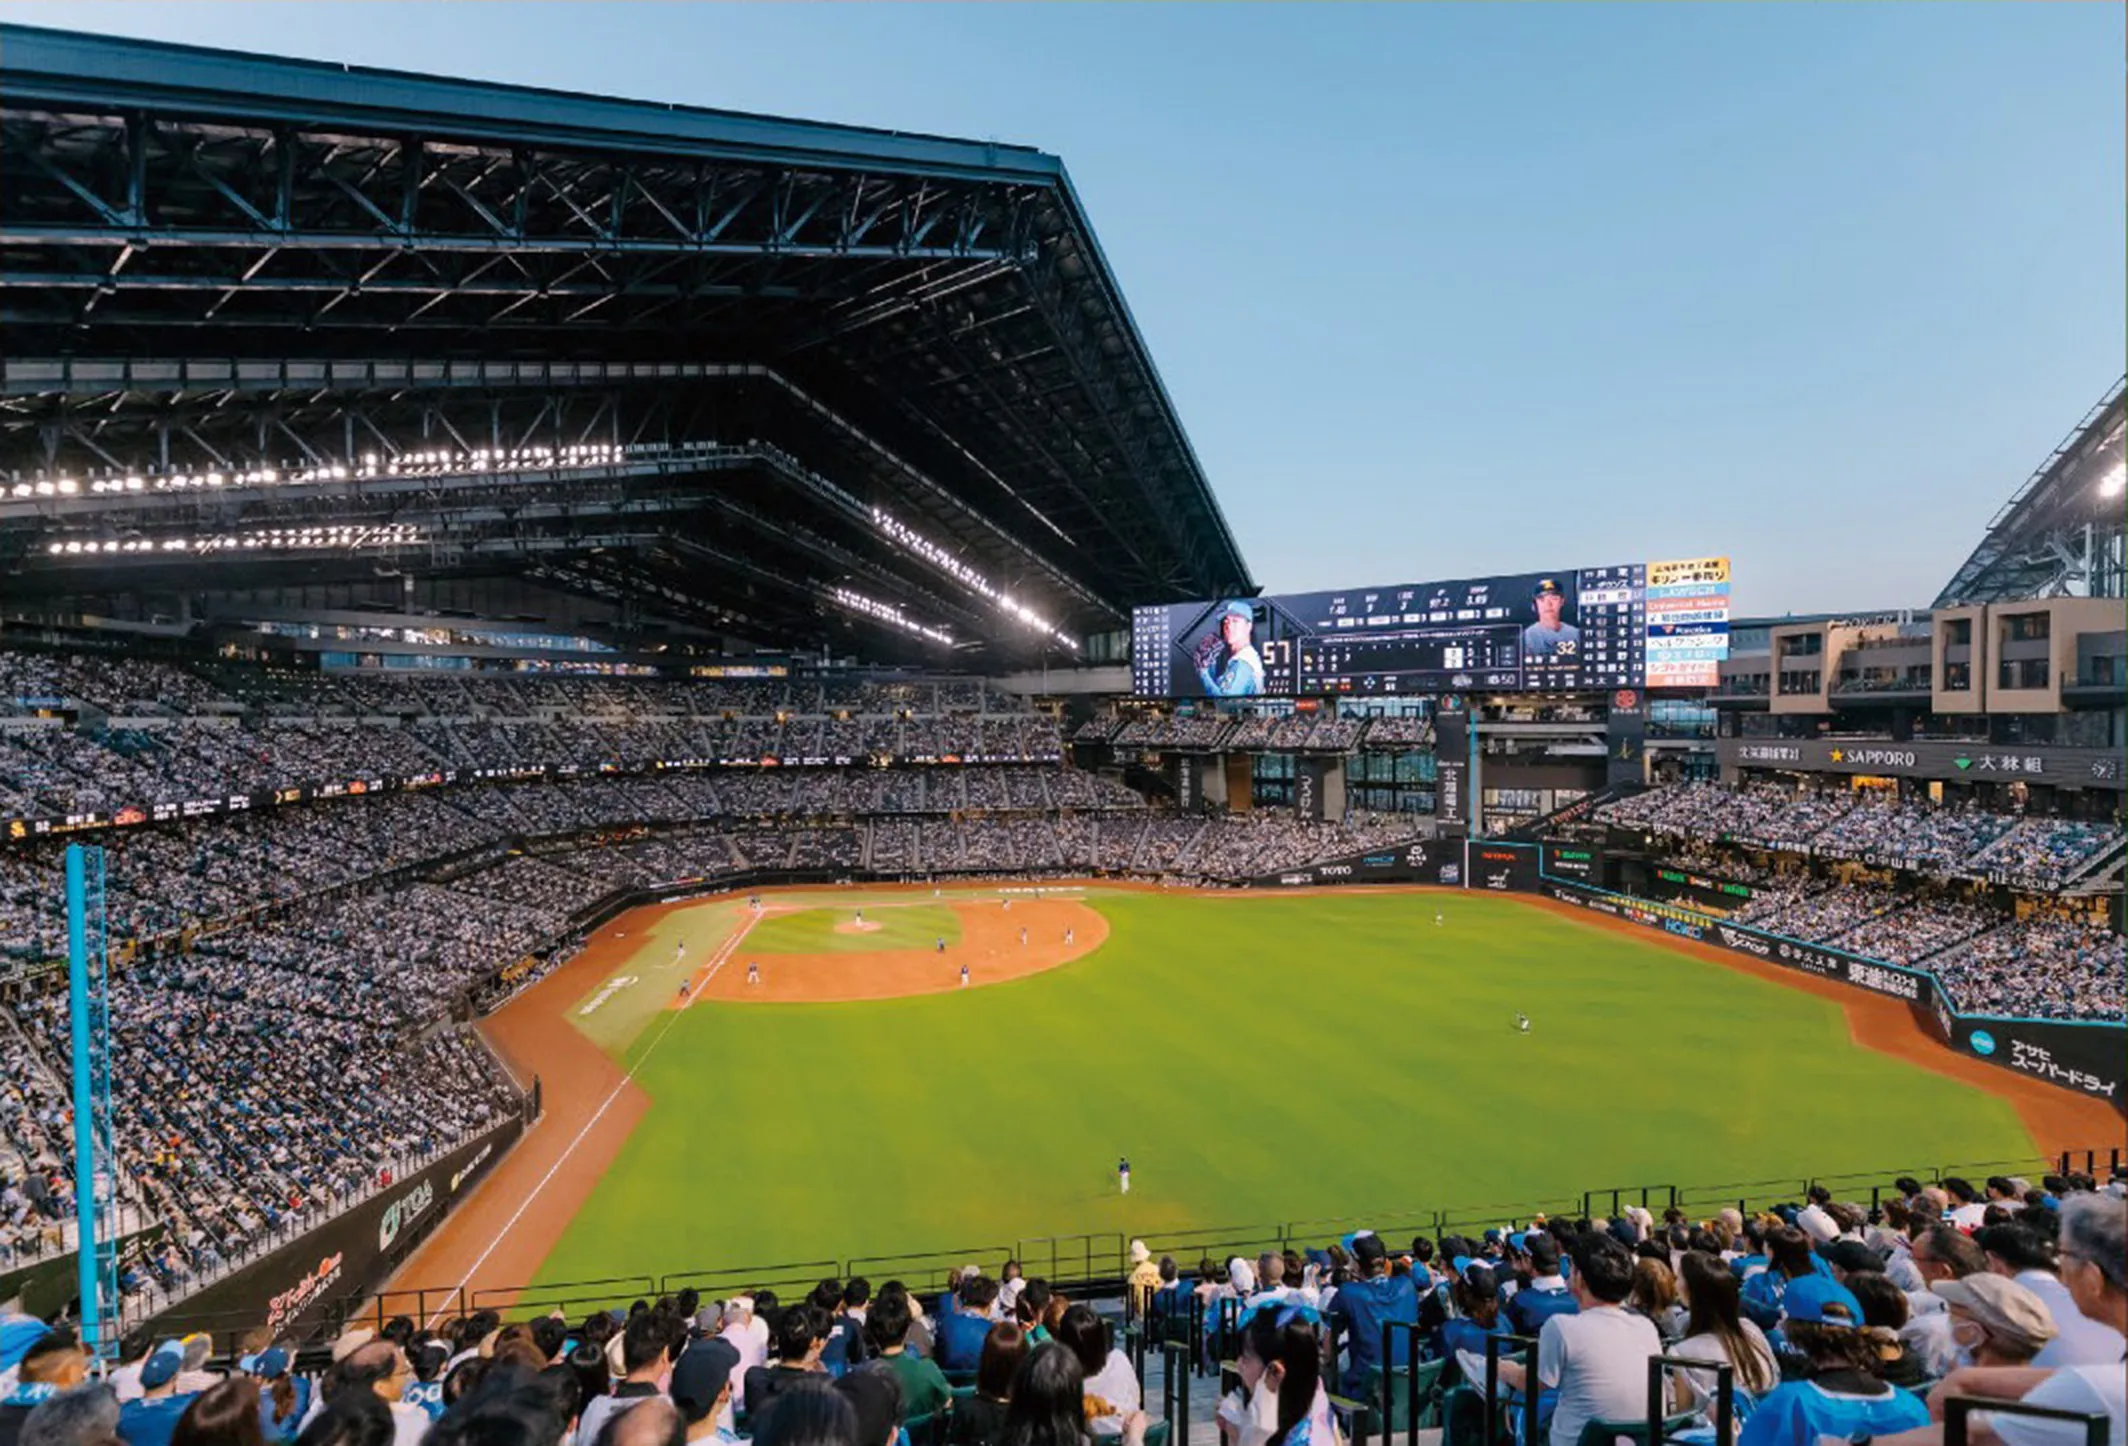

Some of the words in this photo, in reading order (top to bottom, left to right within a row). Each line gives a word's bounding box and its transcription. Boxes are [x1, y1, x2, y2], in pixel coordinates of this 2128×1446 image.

[1262, 641, 1291, 665] 57
[1556, 641, 1577, 655] 32
[1847, 751, 1916, 768] SAPPORO
[1978, 754, 2043, 774] 大林組
[1319, 864, 1353, 877] TOTO
[2010, 1038, 2052, 1062] アサヒ
[2010, 1051, 2117, 1097] スーパードライ
